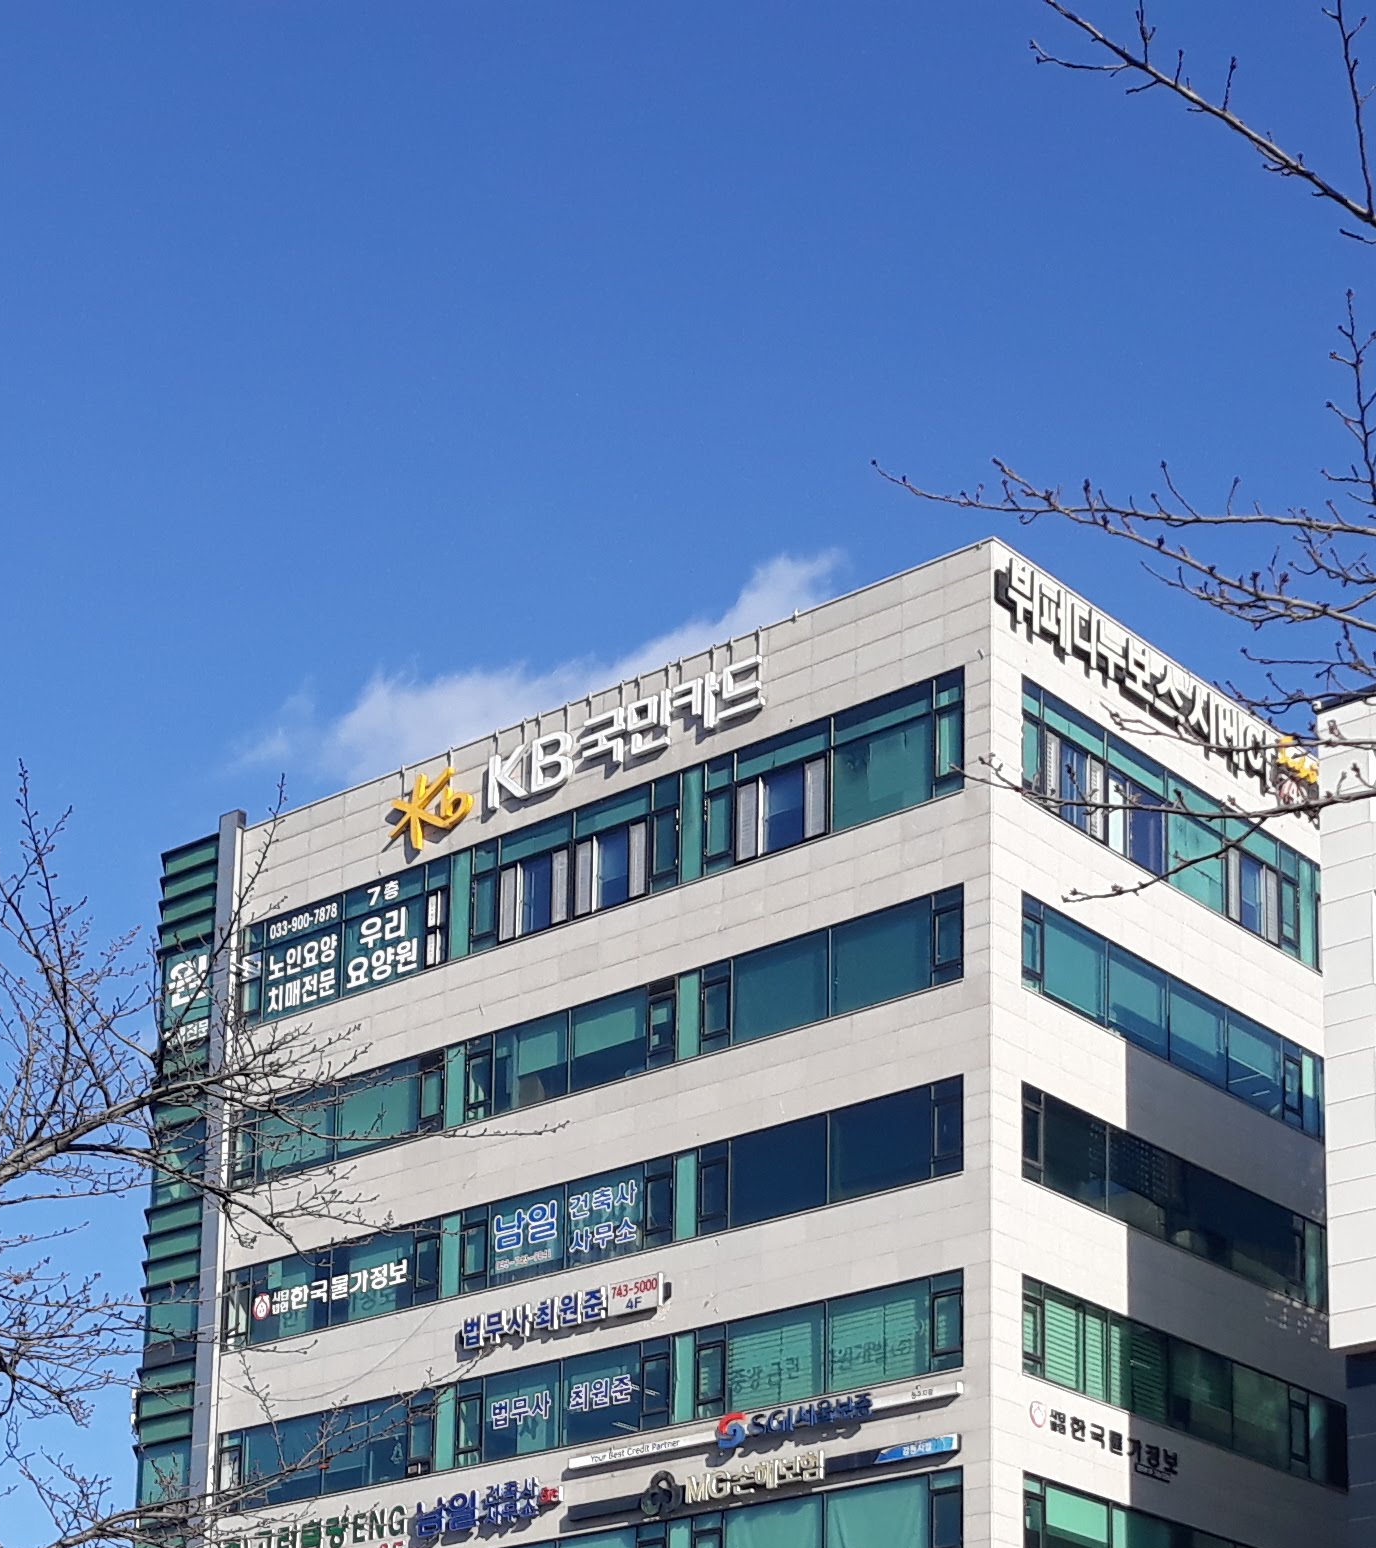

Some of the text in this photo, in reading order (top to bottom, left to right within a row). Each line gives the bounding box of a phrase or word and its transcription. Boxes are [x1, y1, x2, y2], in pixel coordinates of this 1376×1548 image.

[486, 655, 766, 811] KB국민카드
[367, 881, 399, 907] 7층
[270, 902, 338, 940] 033-900-7878
[359, 906, 408, 949] 우리
[268, 933, 338, 981] 노인요양
[346, 938, 418, 989] 요양원
[267, 967, 337, 1013] 치매전문
[494, 1180, 638, 1252] 남일 건축사
[569, 1217, 637, 1253] 사무소
[290, 1258, 409, 1310] 한국물가정보
[611, 1276, 659, 1300] 743-5000
[625, 1296, 643, 1310] 4F
[462, 1285, 606, 1349] 법무사 최원준
[491, 1374, 632, 1430] 법무사 최원준
[590, 1438, 681, 1464] Your Best Credit Partner
